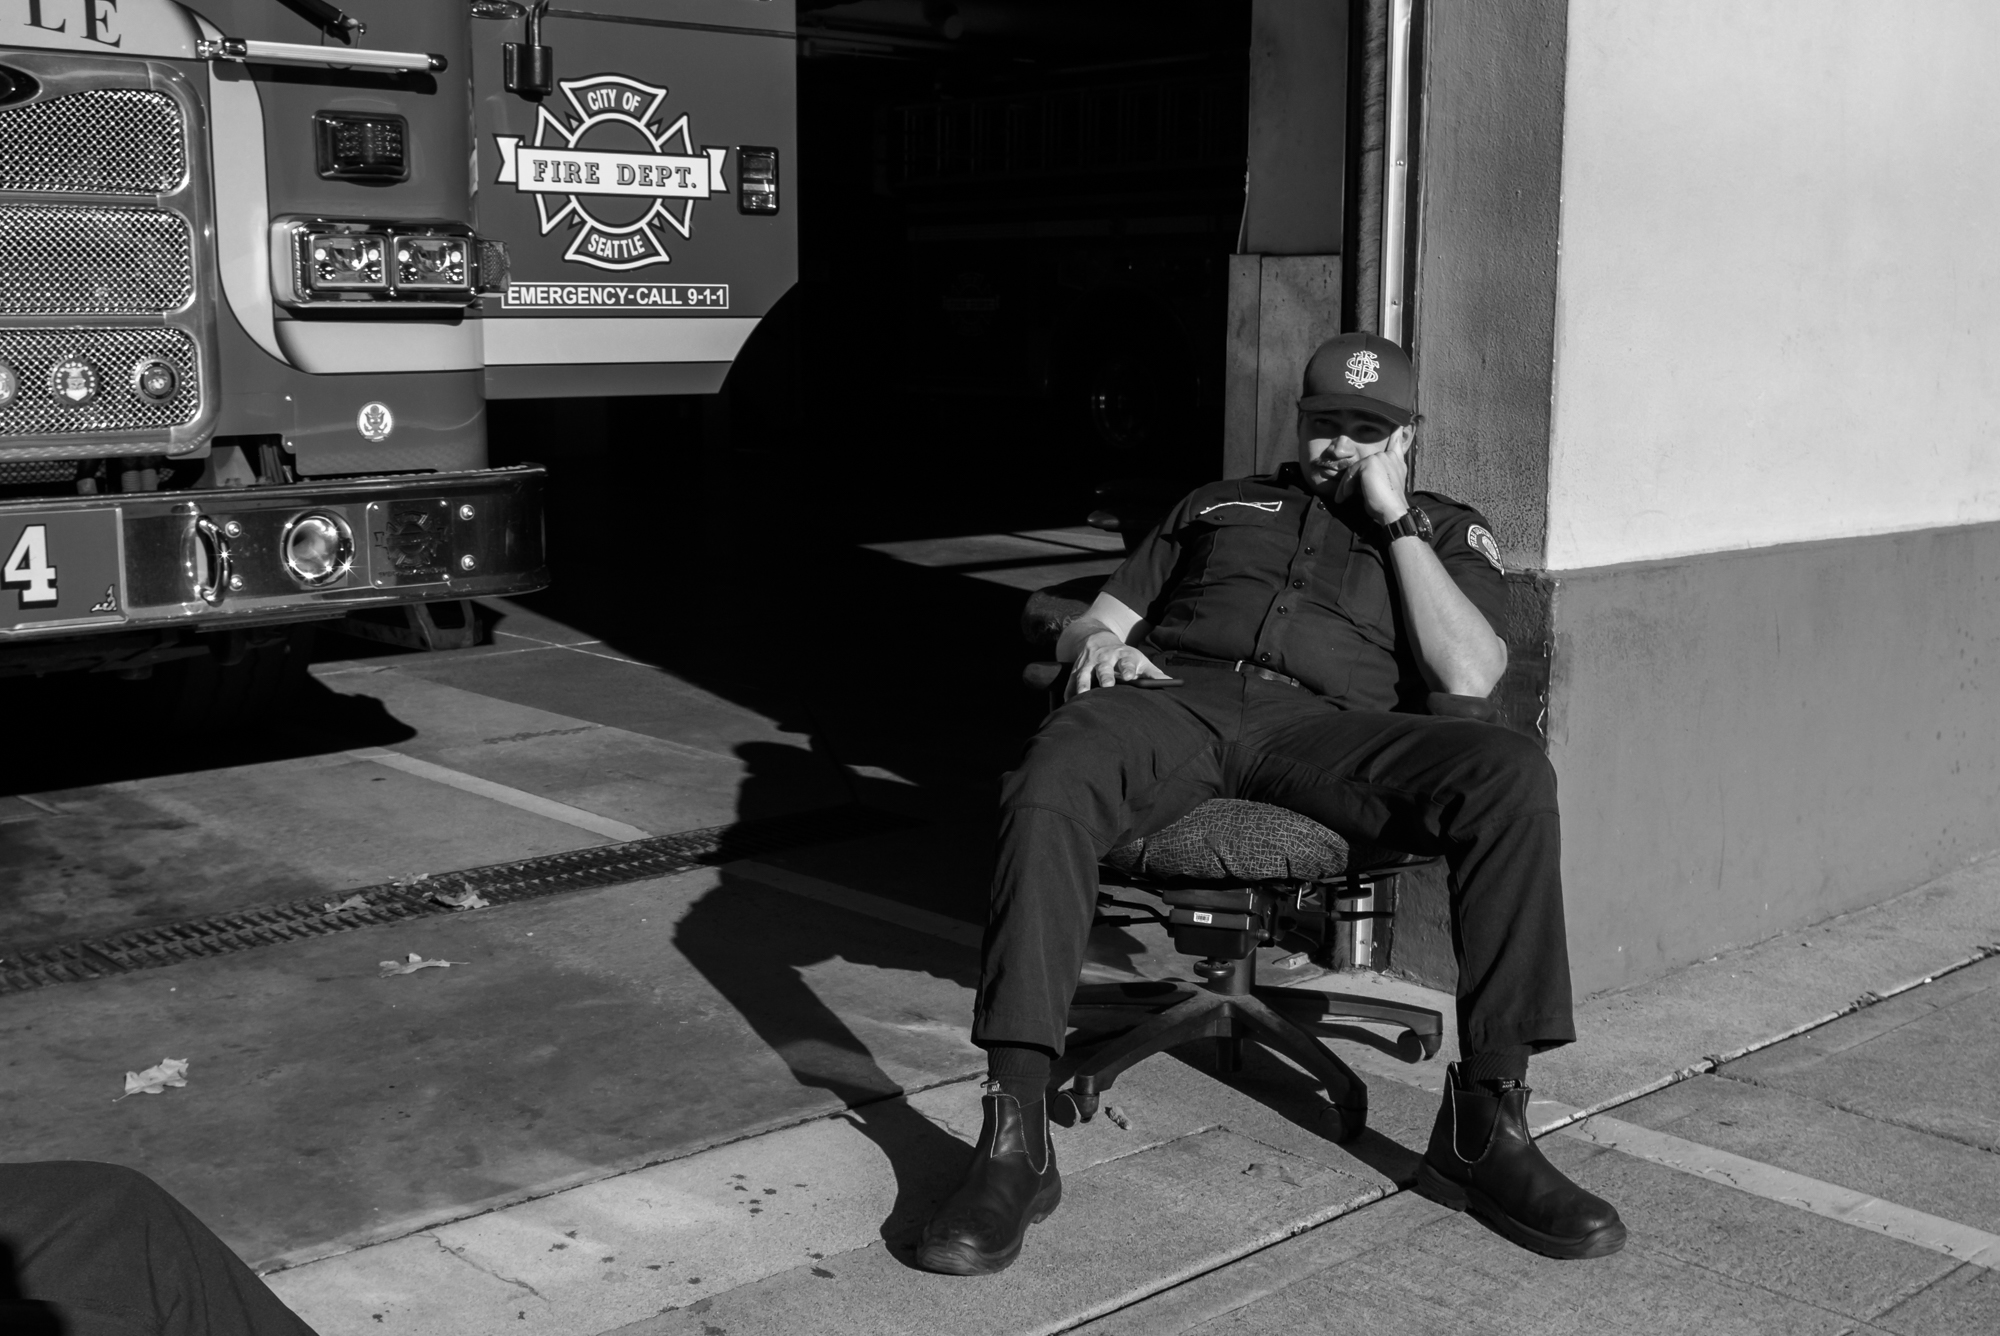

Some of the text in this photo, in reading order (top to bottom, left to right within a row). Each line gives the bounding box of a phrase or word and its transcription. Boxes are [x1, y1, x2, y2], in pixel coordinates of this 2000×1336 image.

[587, 88, 642, 112] CITY OF
[532, 159, 697, 189] FIRE DEPT.
[587, 233, 646, 259] SEATTLE
[507, 286, 725, 305] EMERGENCY-CALL 9-1-1
[2, 524, 58, 608] 4
